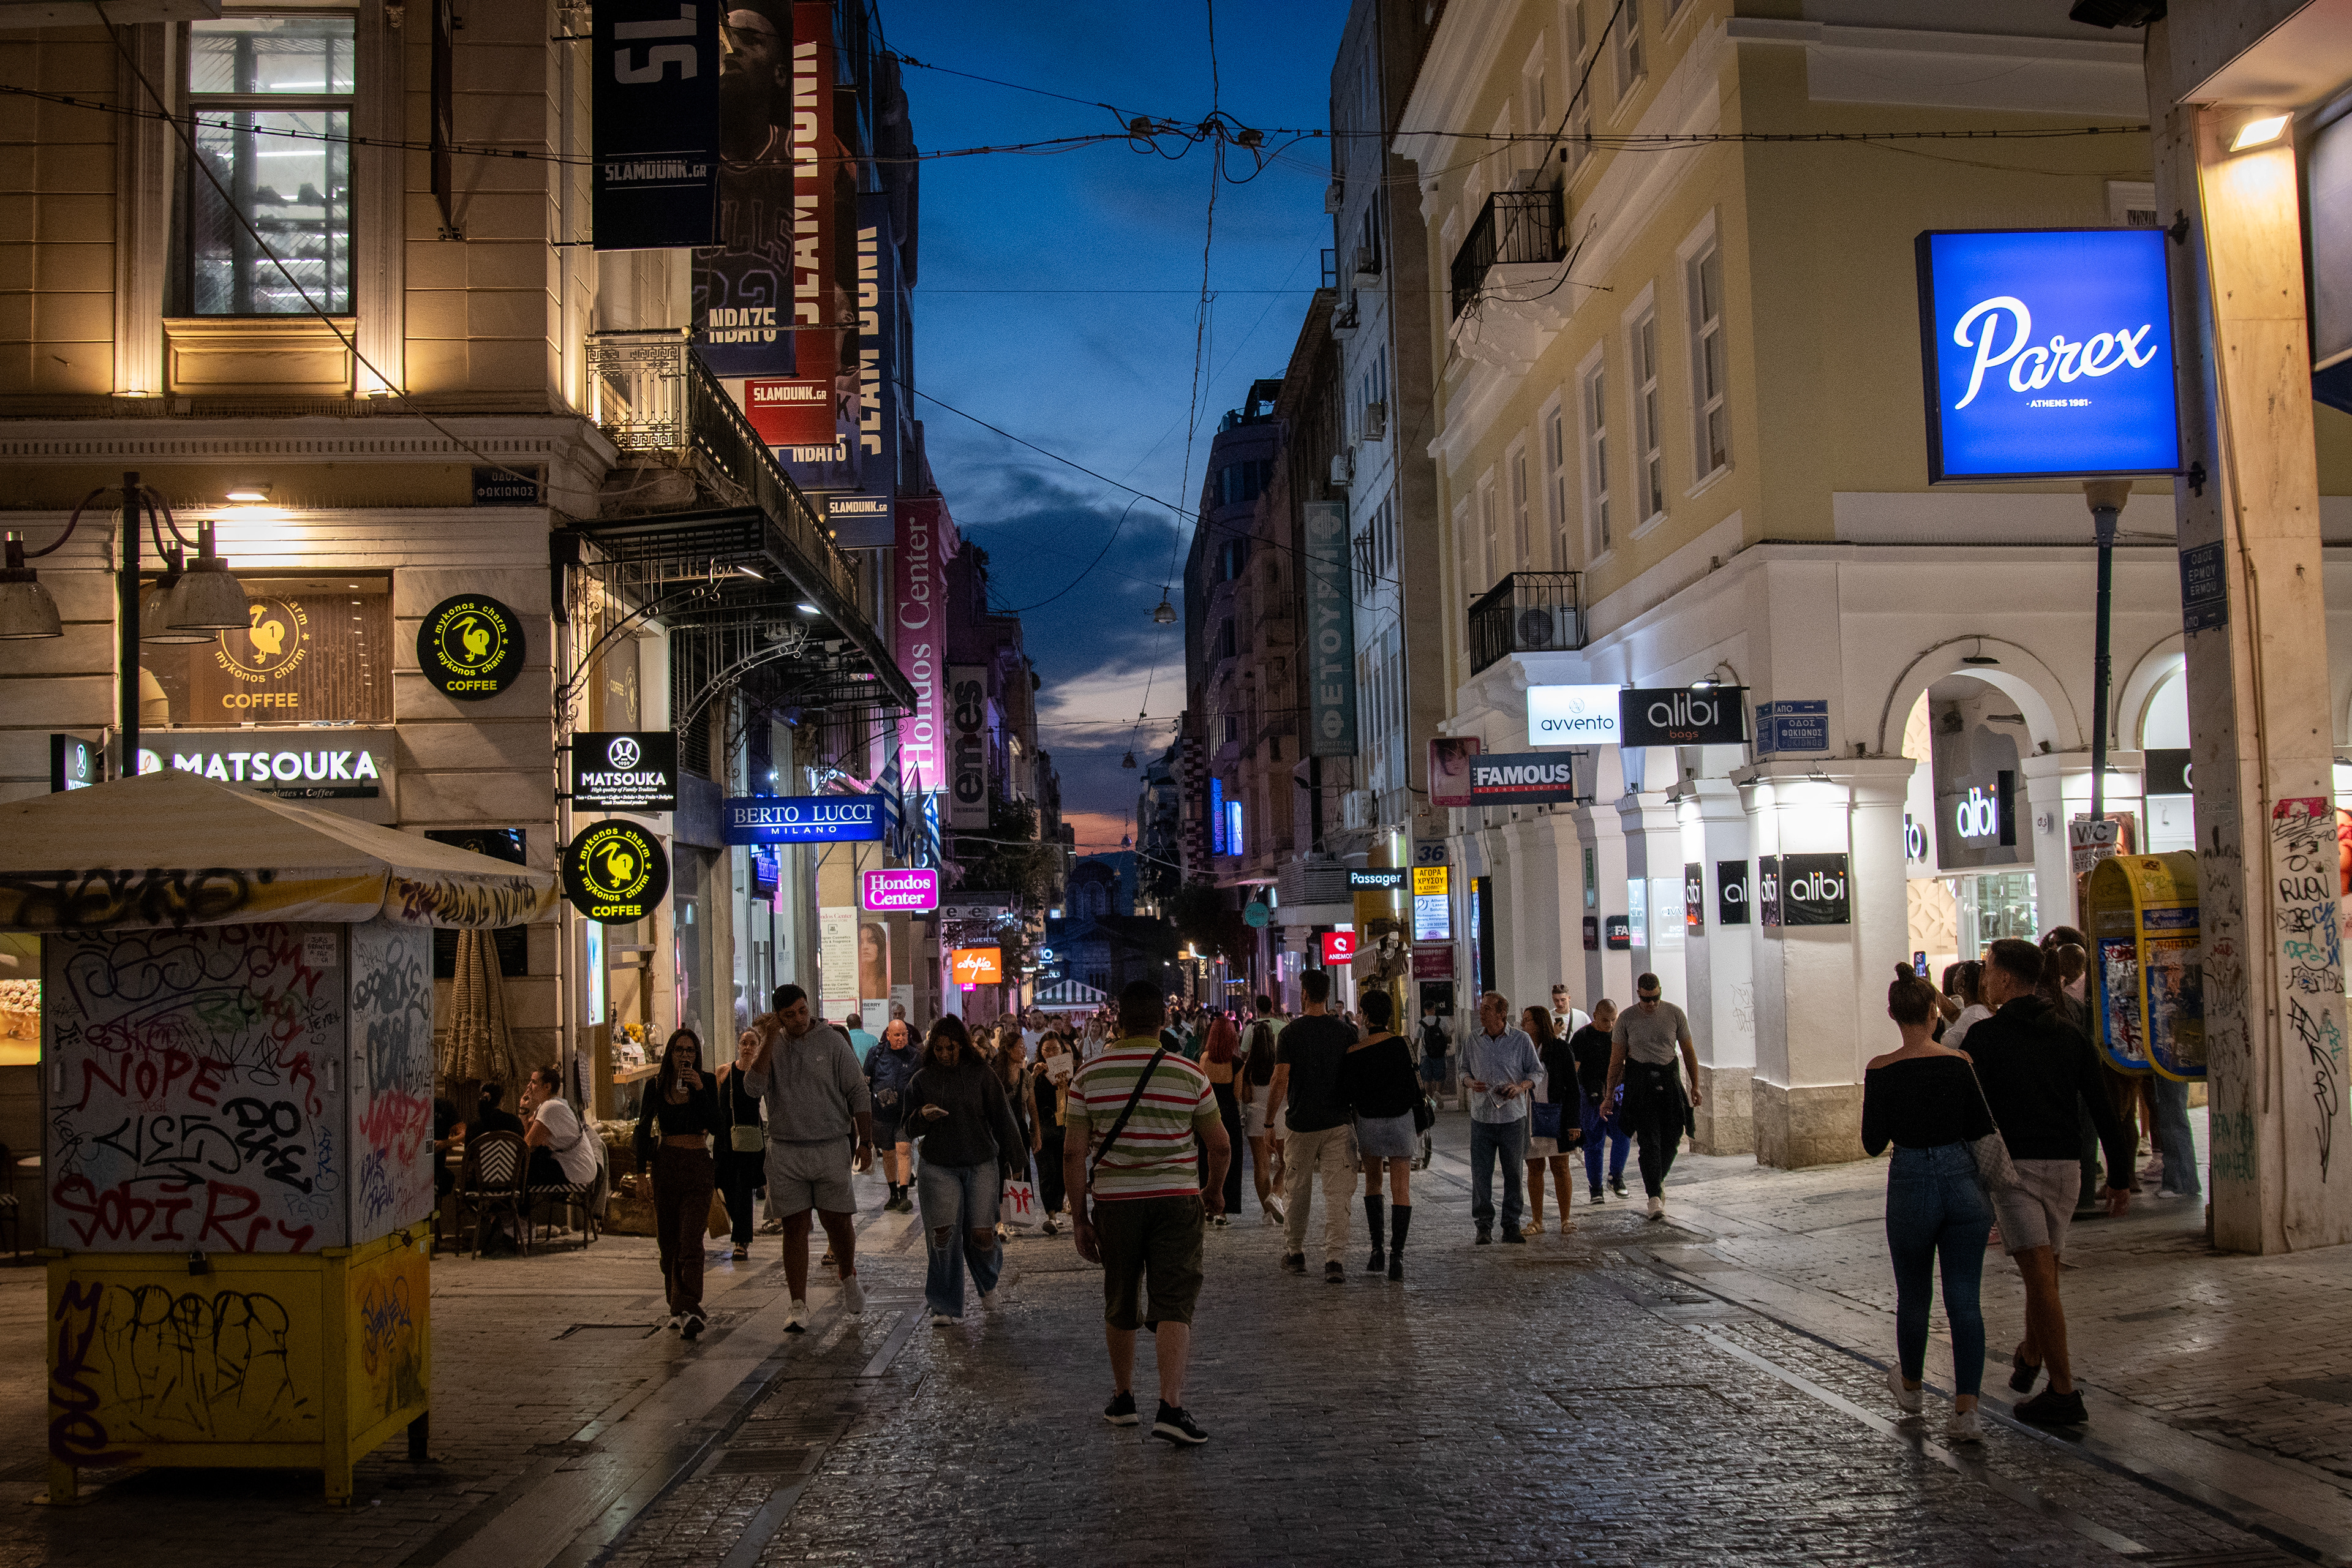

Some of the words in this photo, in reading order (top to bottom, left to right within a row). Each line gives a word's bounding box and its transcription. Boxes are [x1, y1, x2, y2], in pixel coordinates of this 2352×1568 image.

[605, 159, 707, 181] SLAMDUNK.GR
[1953, 296, 2157, 410] Parex
[754, 386, 826, 401] SLAMDUNK.GR
[2030, 399, 2068, 407] ATHENS
[2068, 399, 2089, 407] 1981
[477, 486, 535, 497] ΦΩΚΙΩΝΟΣ
[830, 501, 888, 513] SLAMDUNK.GR
[2191, 550, 2214, 565] ΟΔΟΣ
[899, 516, 930, 630] Center
[2188, 564, 2216, 582] ΕΡΜΟΥ
[2190, 581, 2217, 596] ERMOU
[435, 603, 475, 633] mykonos
[482, 606, 507, 633] charm
[215, 650, 266, 683] mykonos
[274, 648, 306, 679] charm
[437, 651, 476, 676] mykonos
[481, 650, 507, 673] charm
[447, 680, 497, 691] COFFEE
[222, 693, 298, 708] COFFEE
[903, 643, 934, 771] Hondos
[1648, 692, 1719, 728] alibi
[1541, 715, 1614, 731] avvento
[1670, 730, 1698, 740] bags
[172, 750, 379, 781] MATSOUKA
[581, 772, 667, 786] MATSOUKA
[1477, 764, 1570, 786] FAMOUS
[306, 788, 335, 798] Coffee
[734, 806, 799, 824] BERTO
[1956, 784, 1997, 838] alibi
[771, 825, 837, 835] MILANO
[2076, 824, 2108, 843] WC
[579, 827, 618, 859] mykonos
[625, 830, 650, 858] charm
[1418, 846, 1444, 861] 36
[582, 876, 620, 901] mykonos
[626, 874, 649, 899] charm
[870, 875, 931, 891] Hondos
[1351, 872, 1402, 886] Passager
[1790, 871, 1845, 900] alibi
[870, 890, 925, 905] Center
[592, 905, 641, 917] COFFEE
[78, 1048, 233, 1112] NOPE
